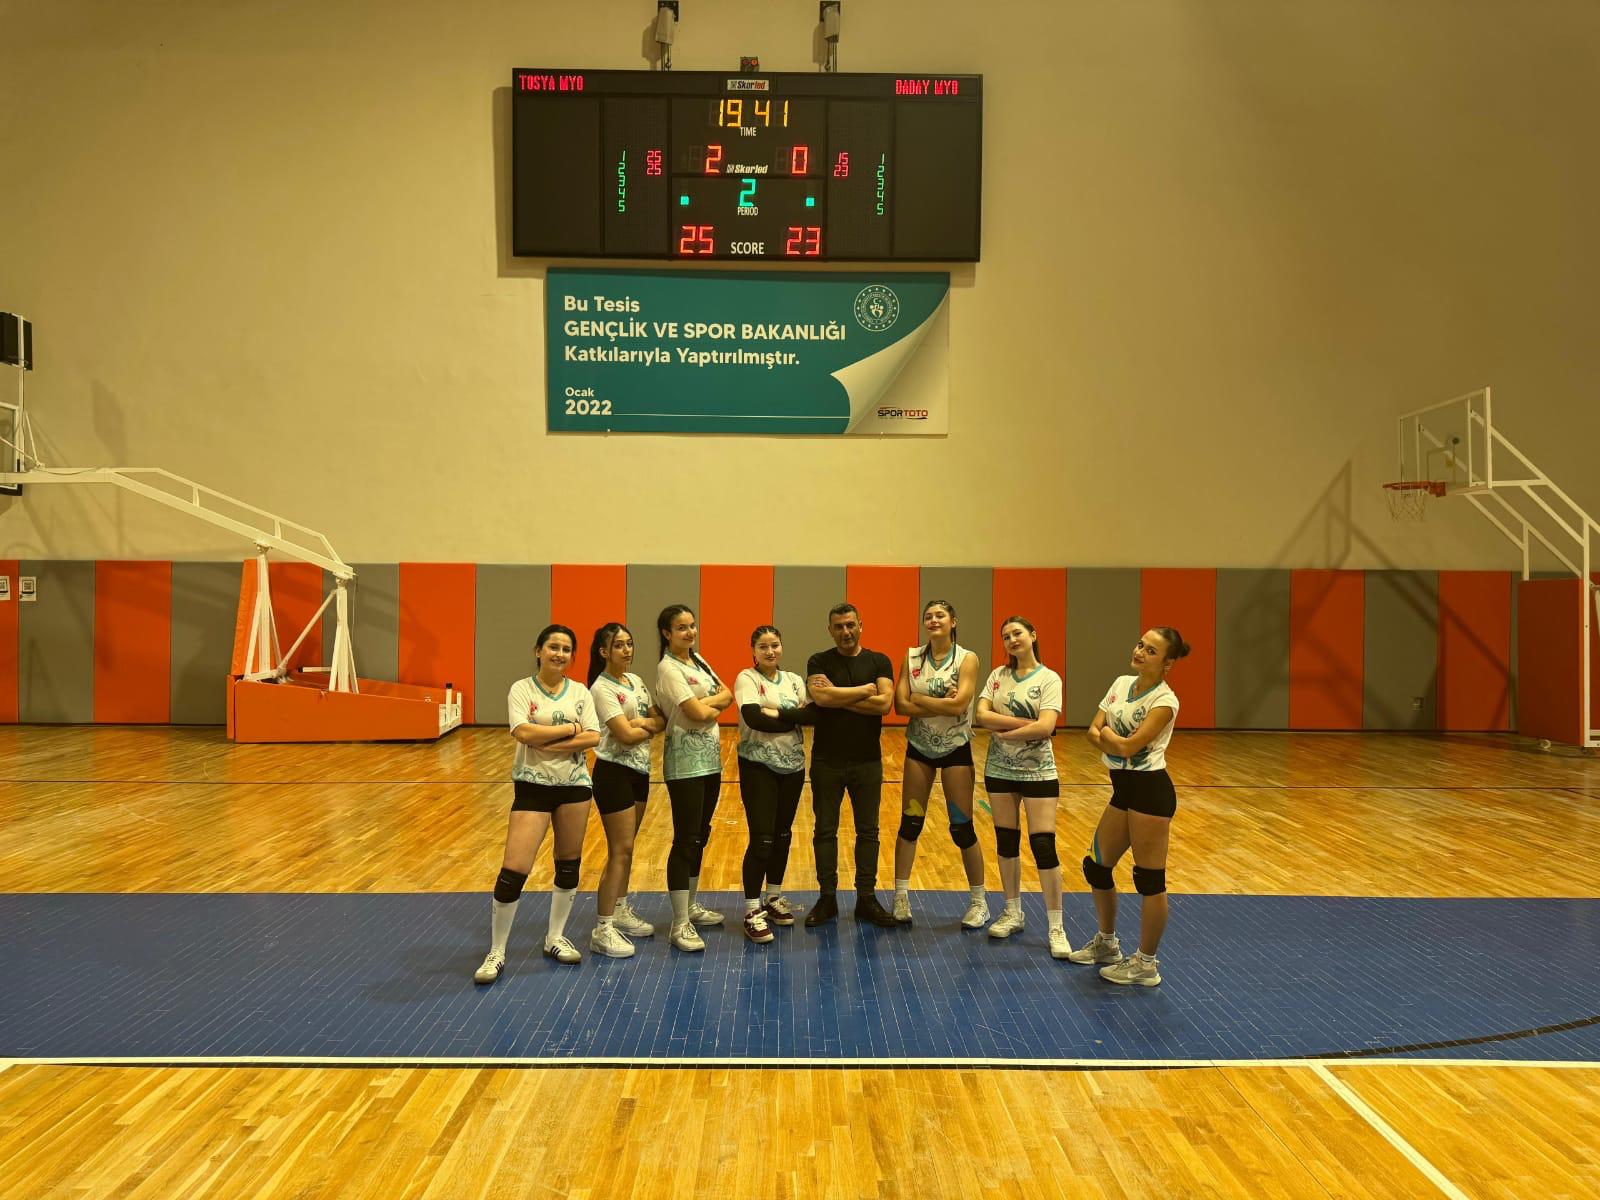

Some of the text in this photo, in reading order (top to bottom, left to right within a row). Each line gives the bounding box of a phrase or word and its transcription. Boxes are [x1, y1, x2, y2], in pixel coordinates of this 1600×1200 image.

[519, 75, 584, 91] TOSYA MYO
[737, 81, 766, 90] Skorled
[895, 79, 959, 96] DADAY MYO
[740, 126, 757, 137] TIME
[646, 150, 662, 163] 25
[705, 145, 722, 173] 2
[792, 146, 808, 174] 0
[646, 163, 662, 176] 25
[735, 164, 769, 175] Skorled
[833, 165, 849, 178] 23
[738, 179, 759, 206] 2
[737, 206, 759, 217] PERIOD
[680, 225, 714, 254] 25
[786, 227, 821, 255] 23
[730, 241, 765, 255] SCORE
[565, 296, 640, 313] Bu Tesis
[565, 318, 846, 342] GENÇLİK VE SPOR BAKANLIĞI
[565, 346, 800, 370] Katkılarıyla Yaptırılmıştır.
[565, 386, 595, 397] Ocak
[565, 399, 612, 415] 2022
